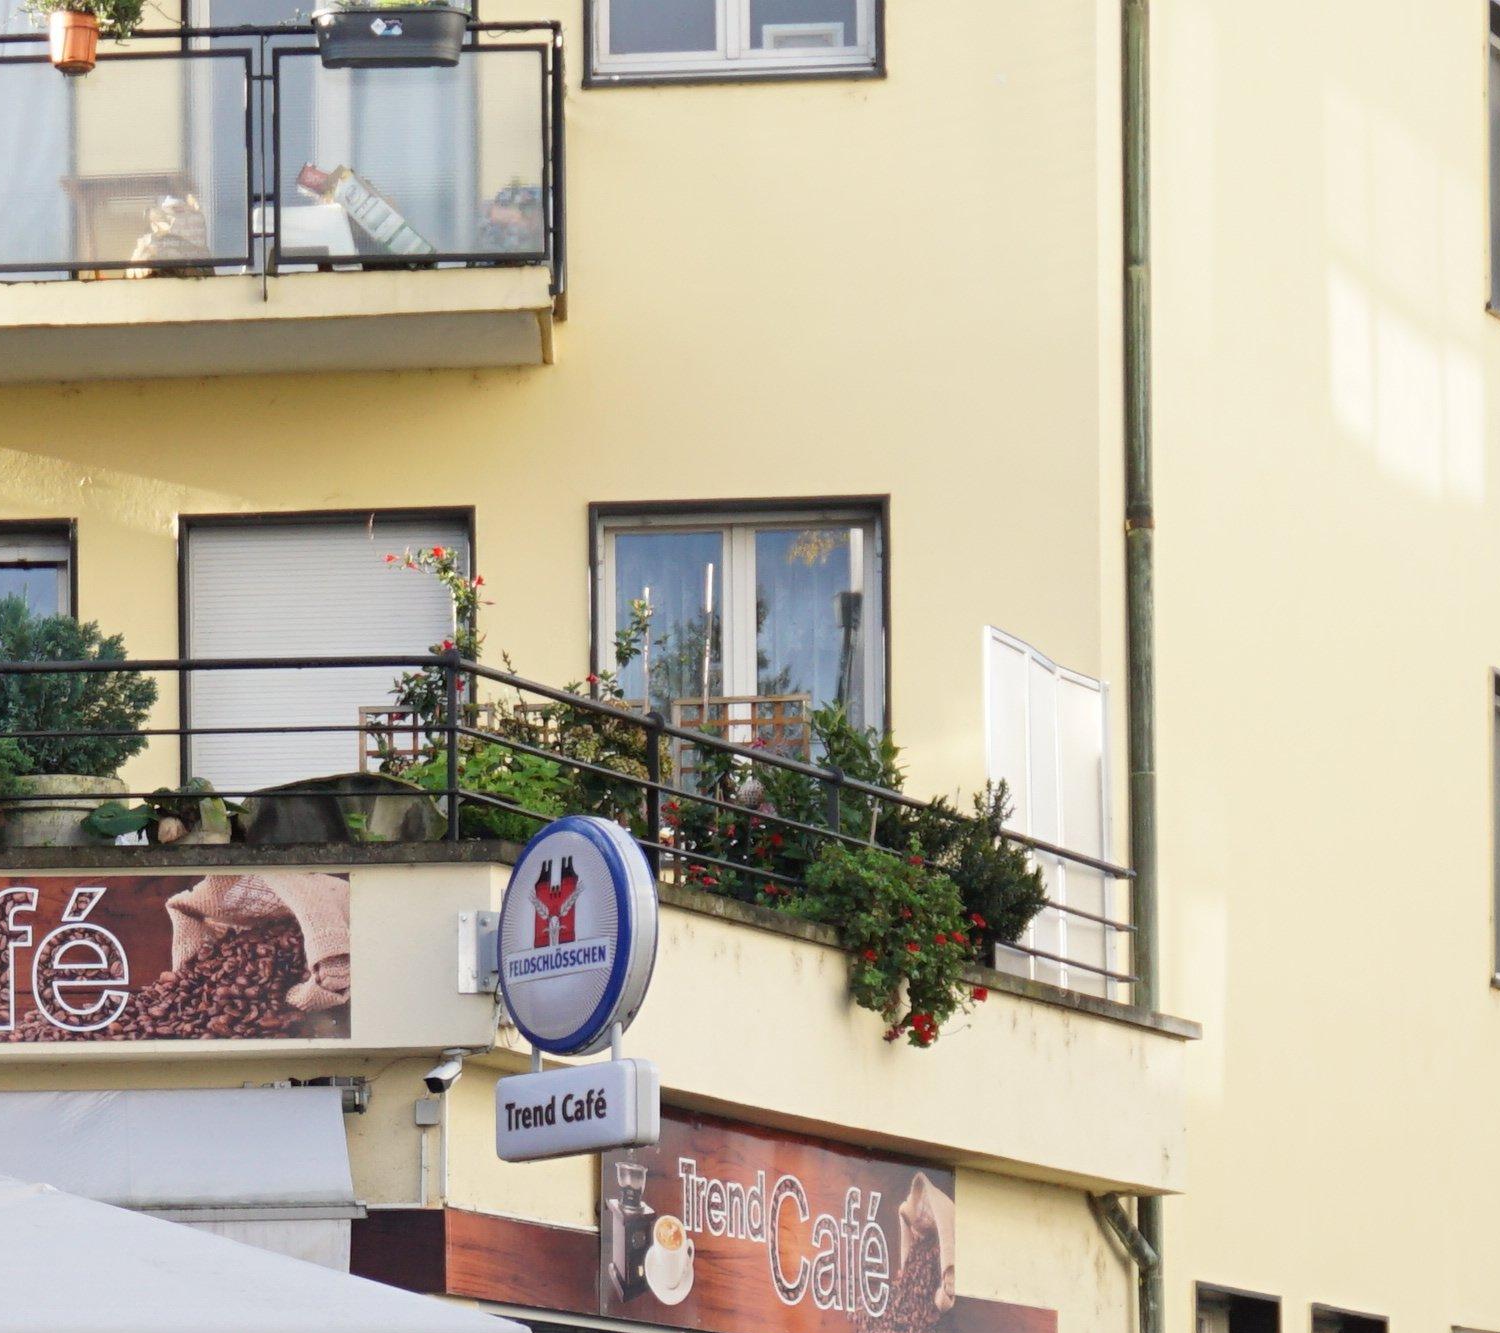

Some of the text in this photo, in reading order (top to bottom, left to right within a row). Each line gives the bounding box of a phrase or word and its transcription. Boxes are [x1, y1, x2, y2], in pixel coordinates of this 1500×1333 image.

[509, 945, 608, 978] FELDSCHLÖSSCHEN
[505, 1087, 607, 1132] Trend Café
[679, 1157, 890, 1318] Trend Café
